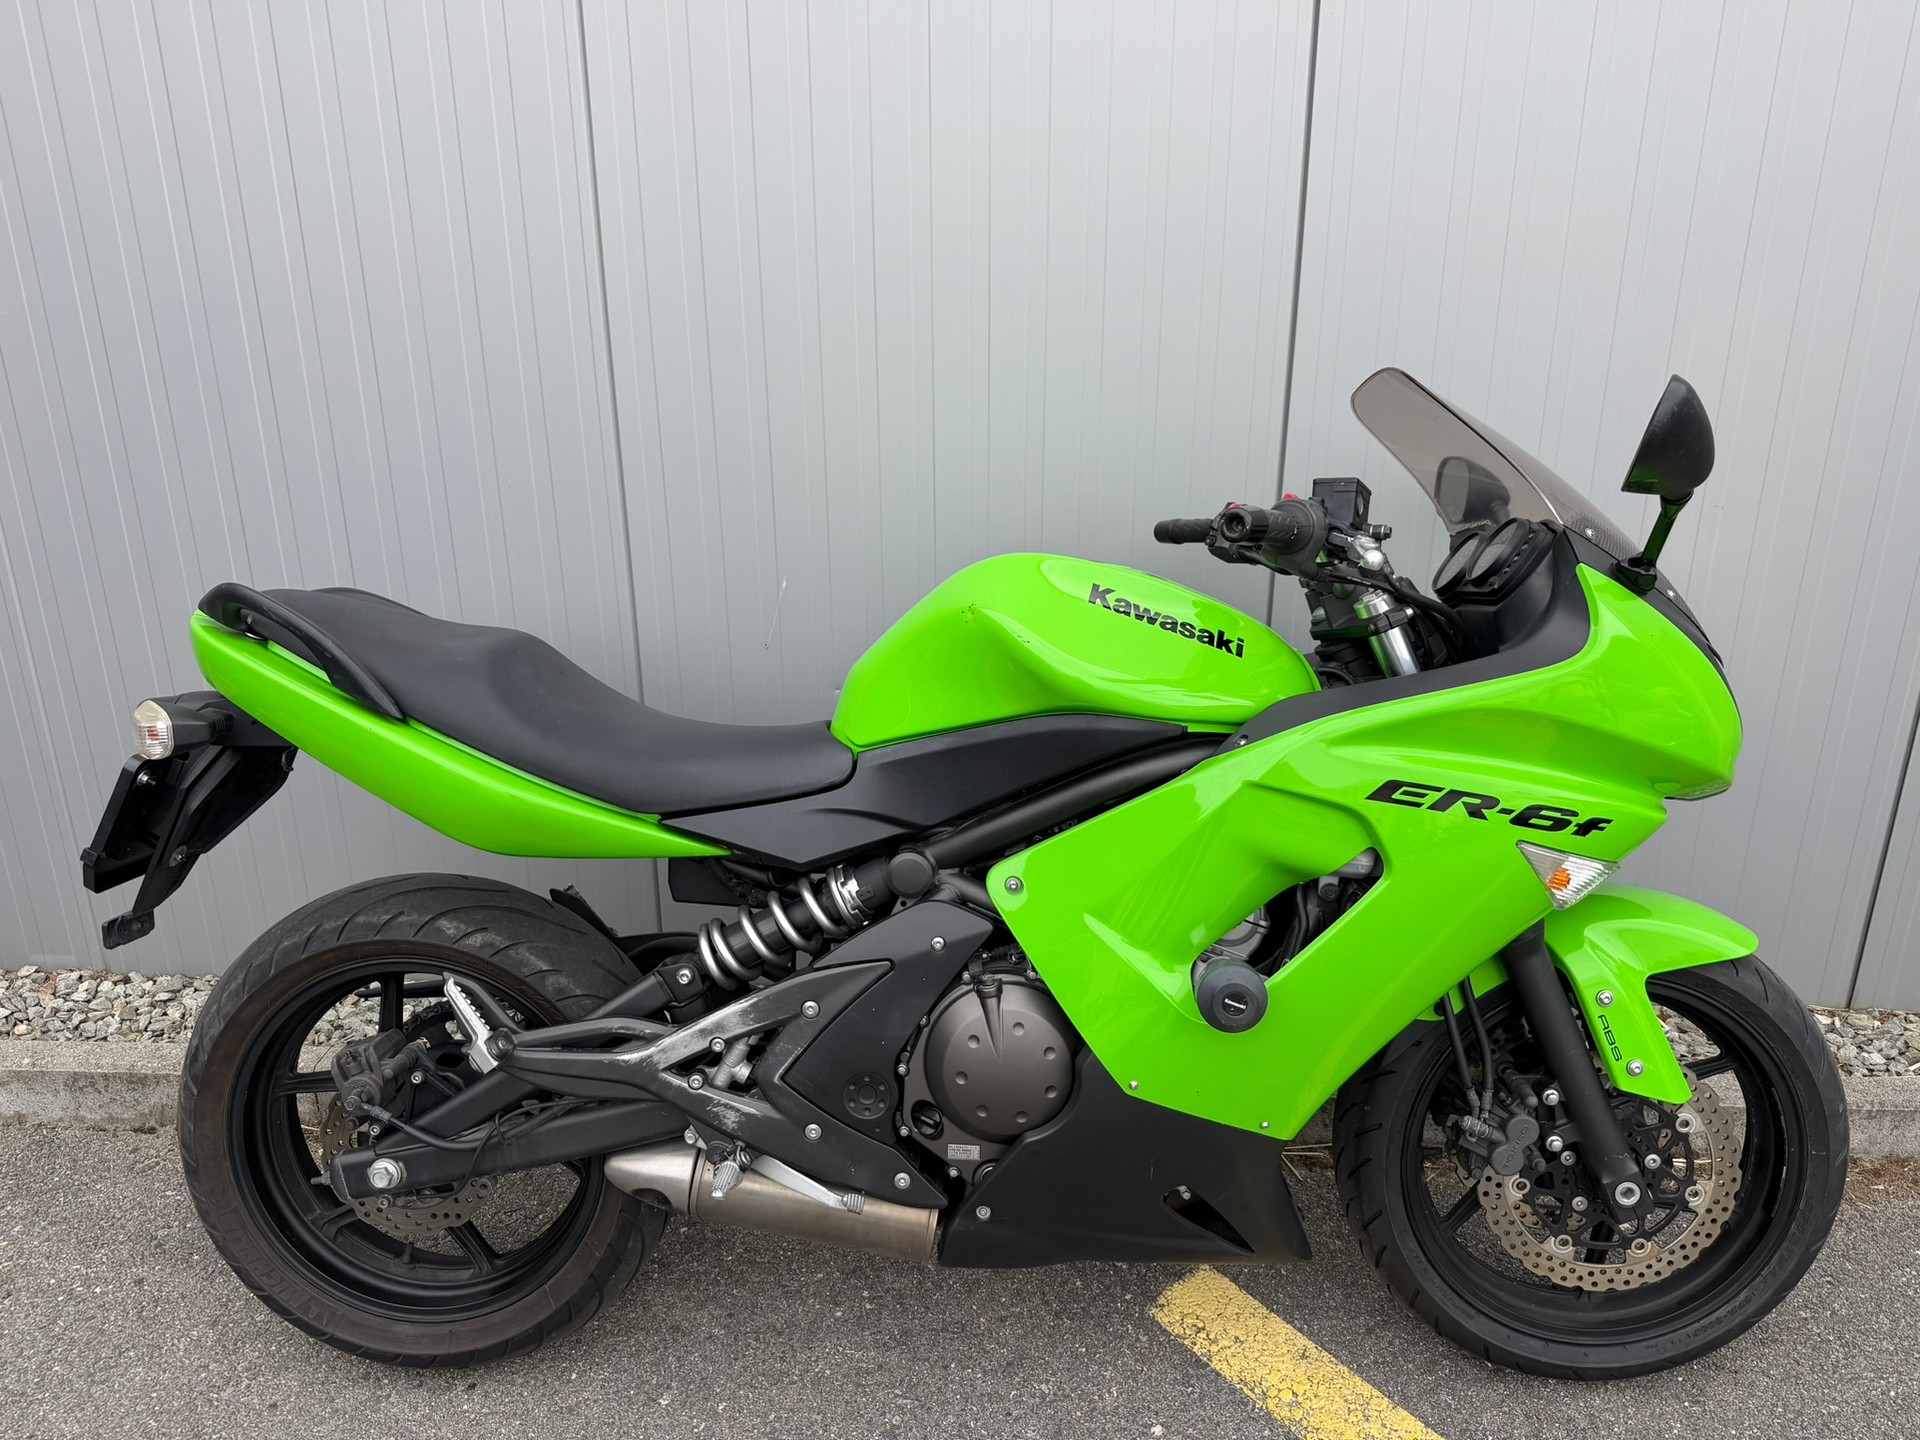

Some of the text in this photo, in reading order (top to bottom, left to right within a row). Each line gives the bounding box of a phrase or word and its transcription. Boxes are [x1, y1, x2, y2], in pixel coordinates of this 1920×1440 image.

[1088, 583, 1245, 658] Kawasaki
[1364, 779, 1614, 837] ER-6f
[1598, 1014, 1622, 1062] ABS
